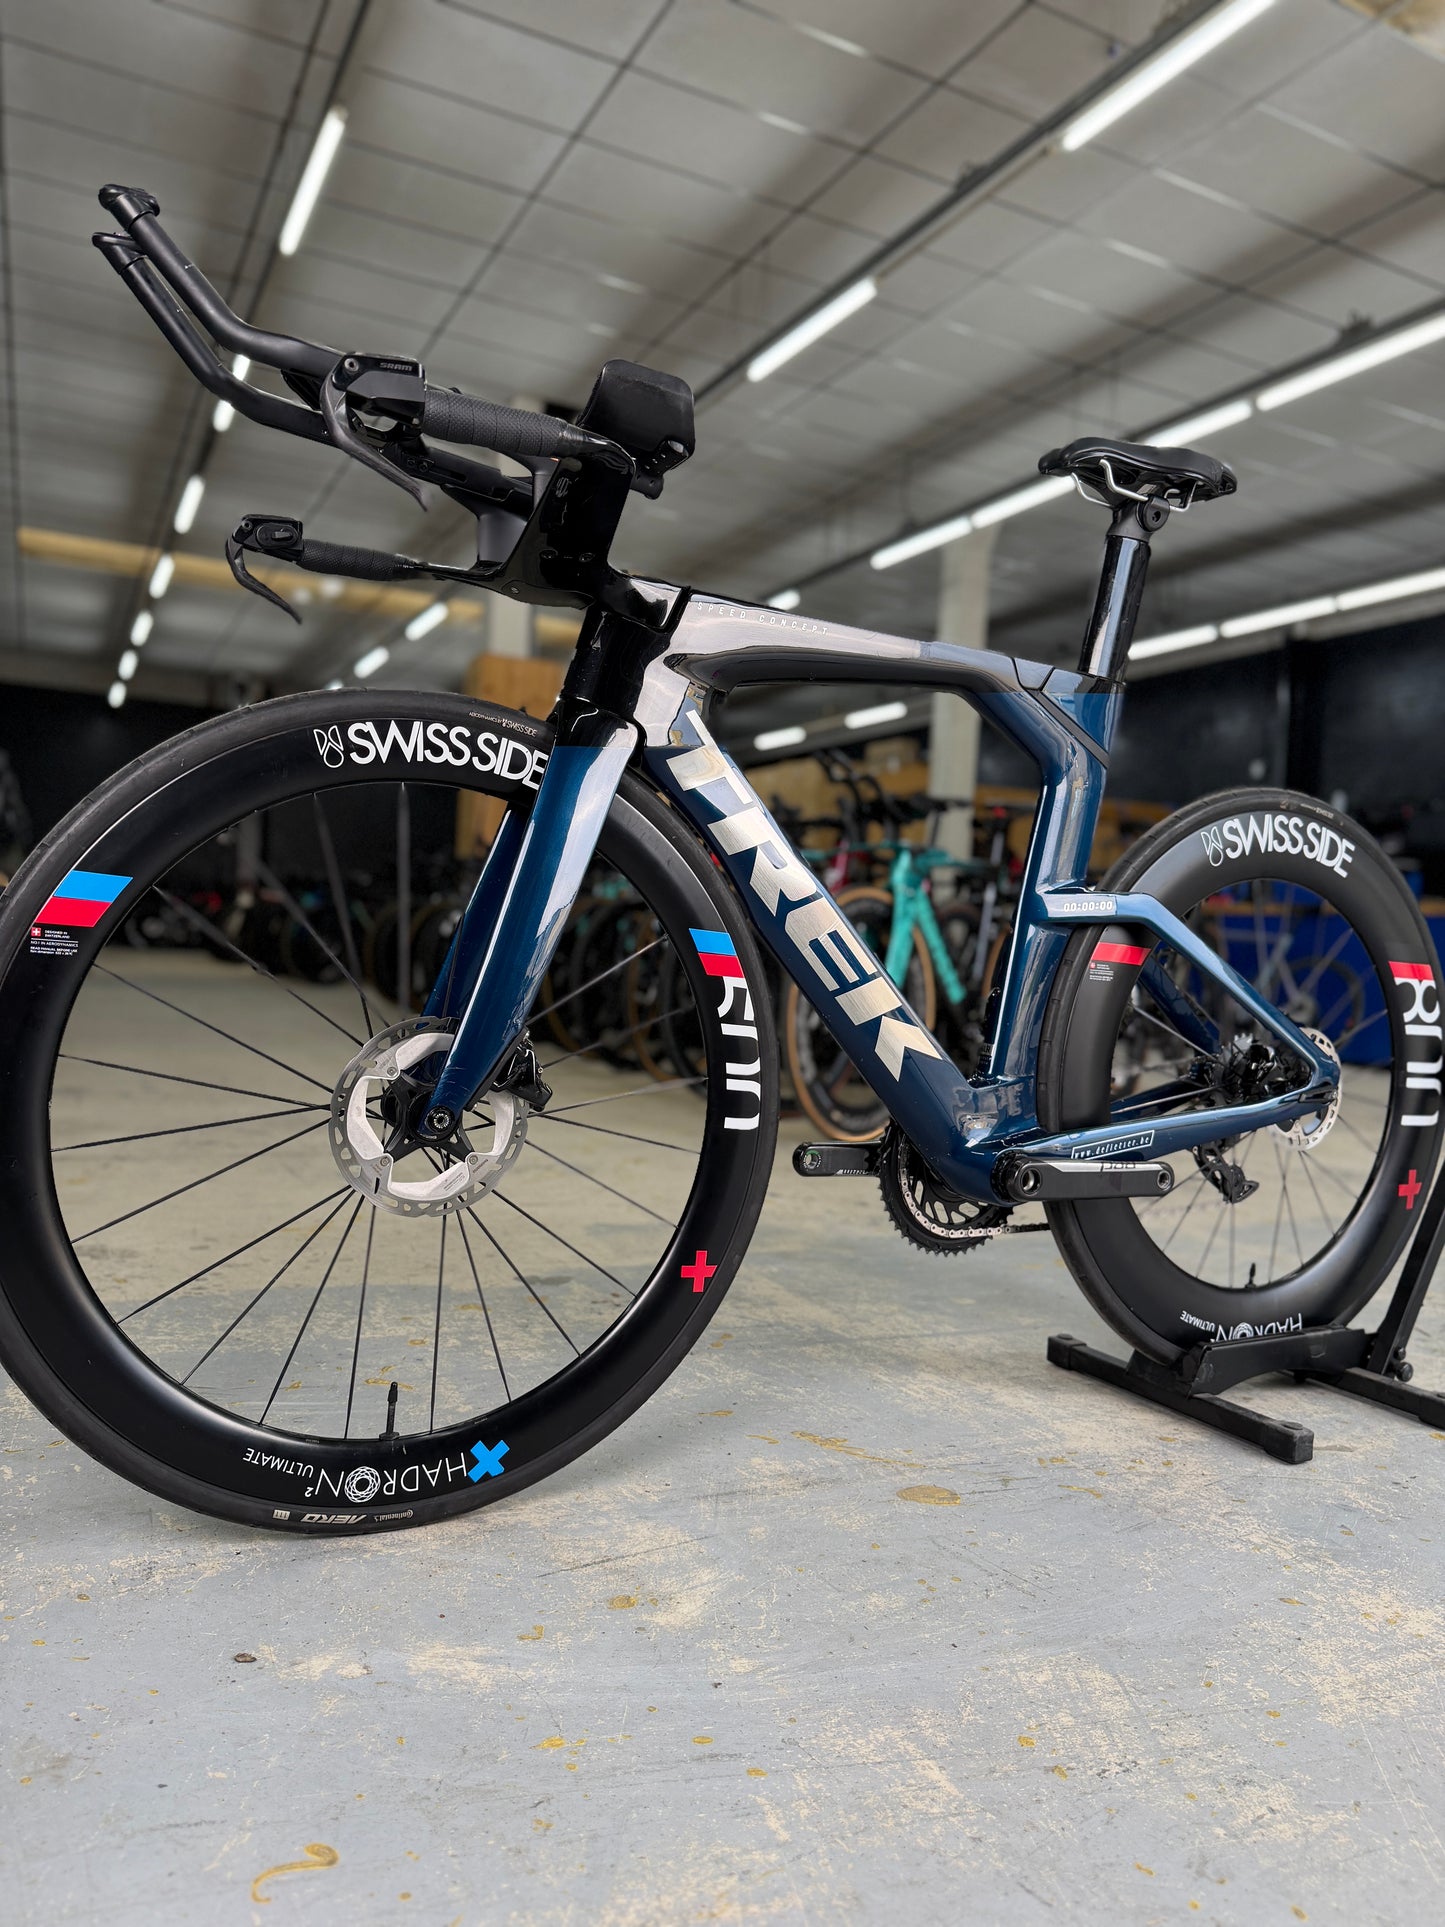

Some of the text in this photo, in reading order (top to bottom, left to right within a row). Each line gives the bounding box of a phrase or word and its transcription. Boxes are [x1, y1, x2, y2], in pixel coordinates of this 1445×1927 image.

[380, 362, 413, 372] SRAM
[697, 602, 828, 635] SPEED CONCEPT
[507, 720, 524, 733] SWISS
[524, 726, 538, 737] SIDE
[347, 719, 549, 790] SWISS SIDE
[1222, 814, 1356, 879] SWISS SIDE
[666, 709, 943, 1082] TREK
[1063, 901, 1113, 912] 00:00:00
[1179, 1310, 1216, 1332] ULTIMATE
[242, 1448, 314, 1478] ULTIMATE
[300, 1513, 367, 1524] AERO
